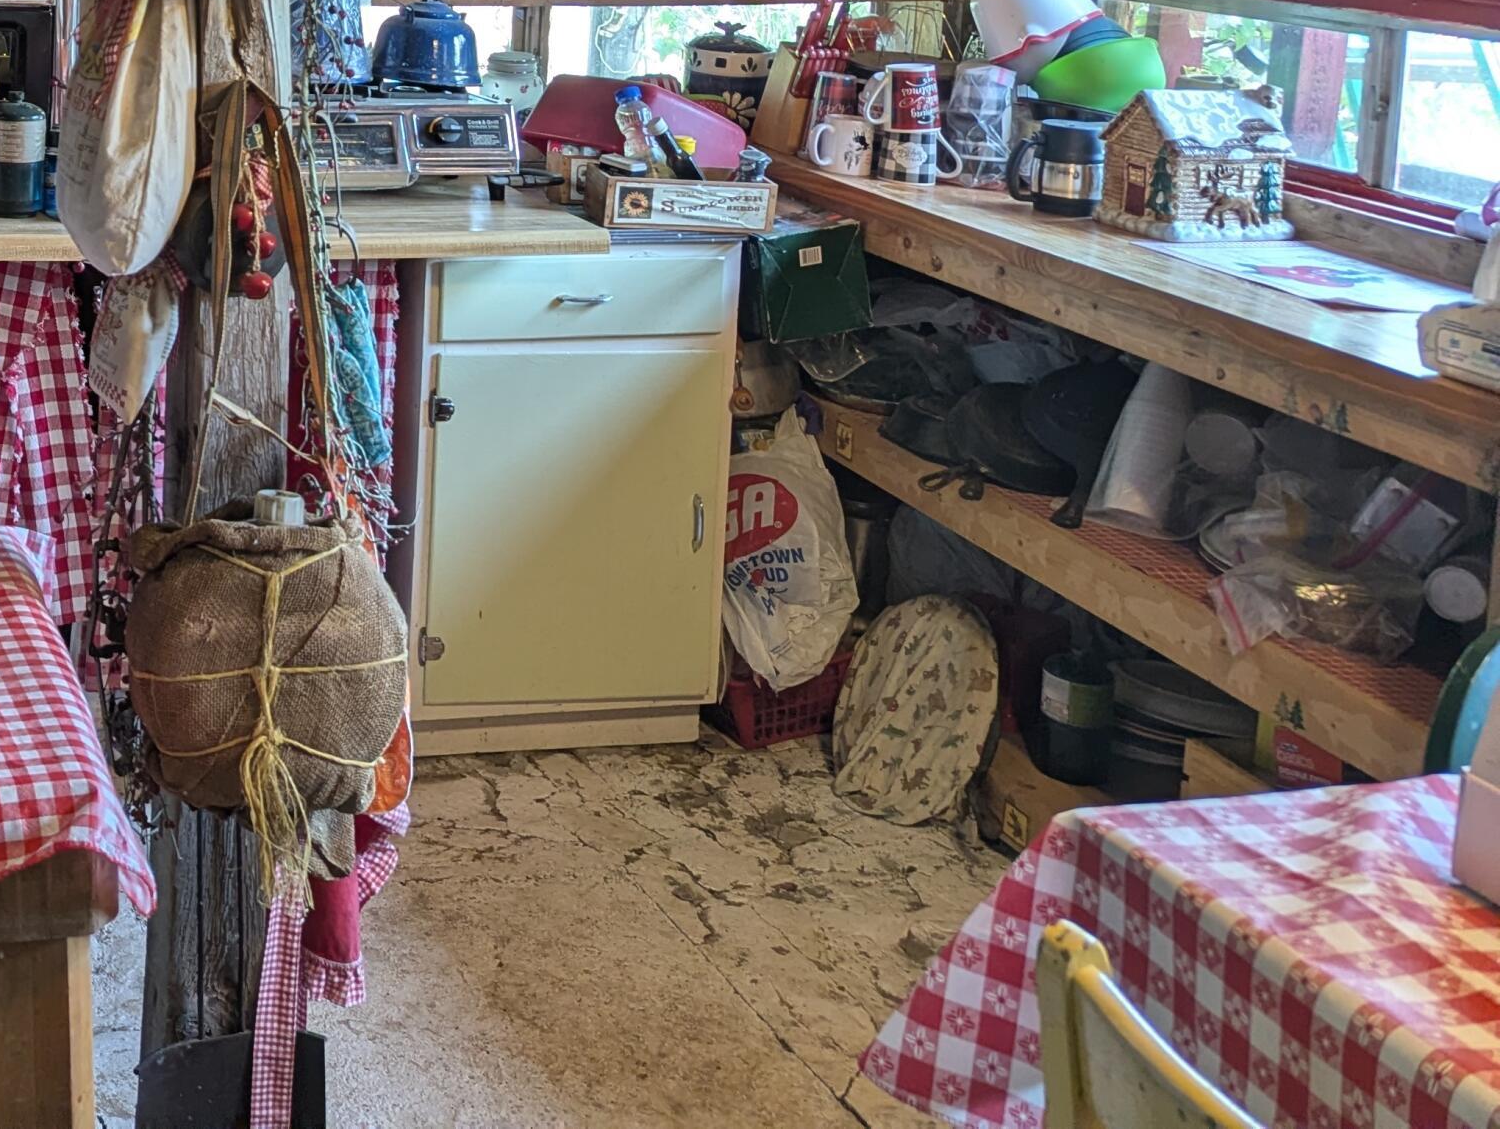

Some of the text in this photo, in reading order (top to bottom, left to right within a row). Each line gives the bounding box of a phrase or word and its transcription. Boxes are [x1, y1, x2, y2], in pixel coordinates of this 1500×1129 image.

[660, 195, 764, 214] SUNFLOWER
[726, 204, 761, 213] SEEDS
[726, 547, 806, 593] OMETOWN
